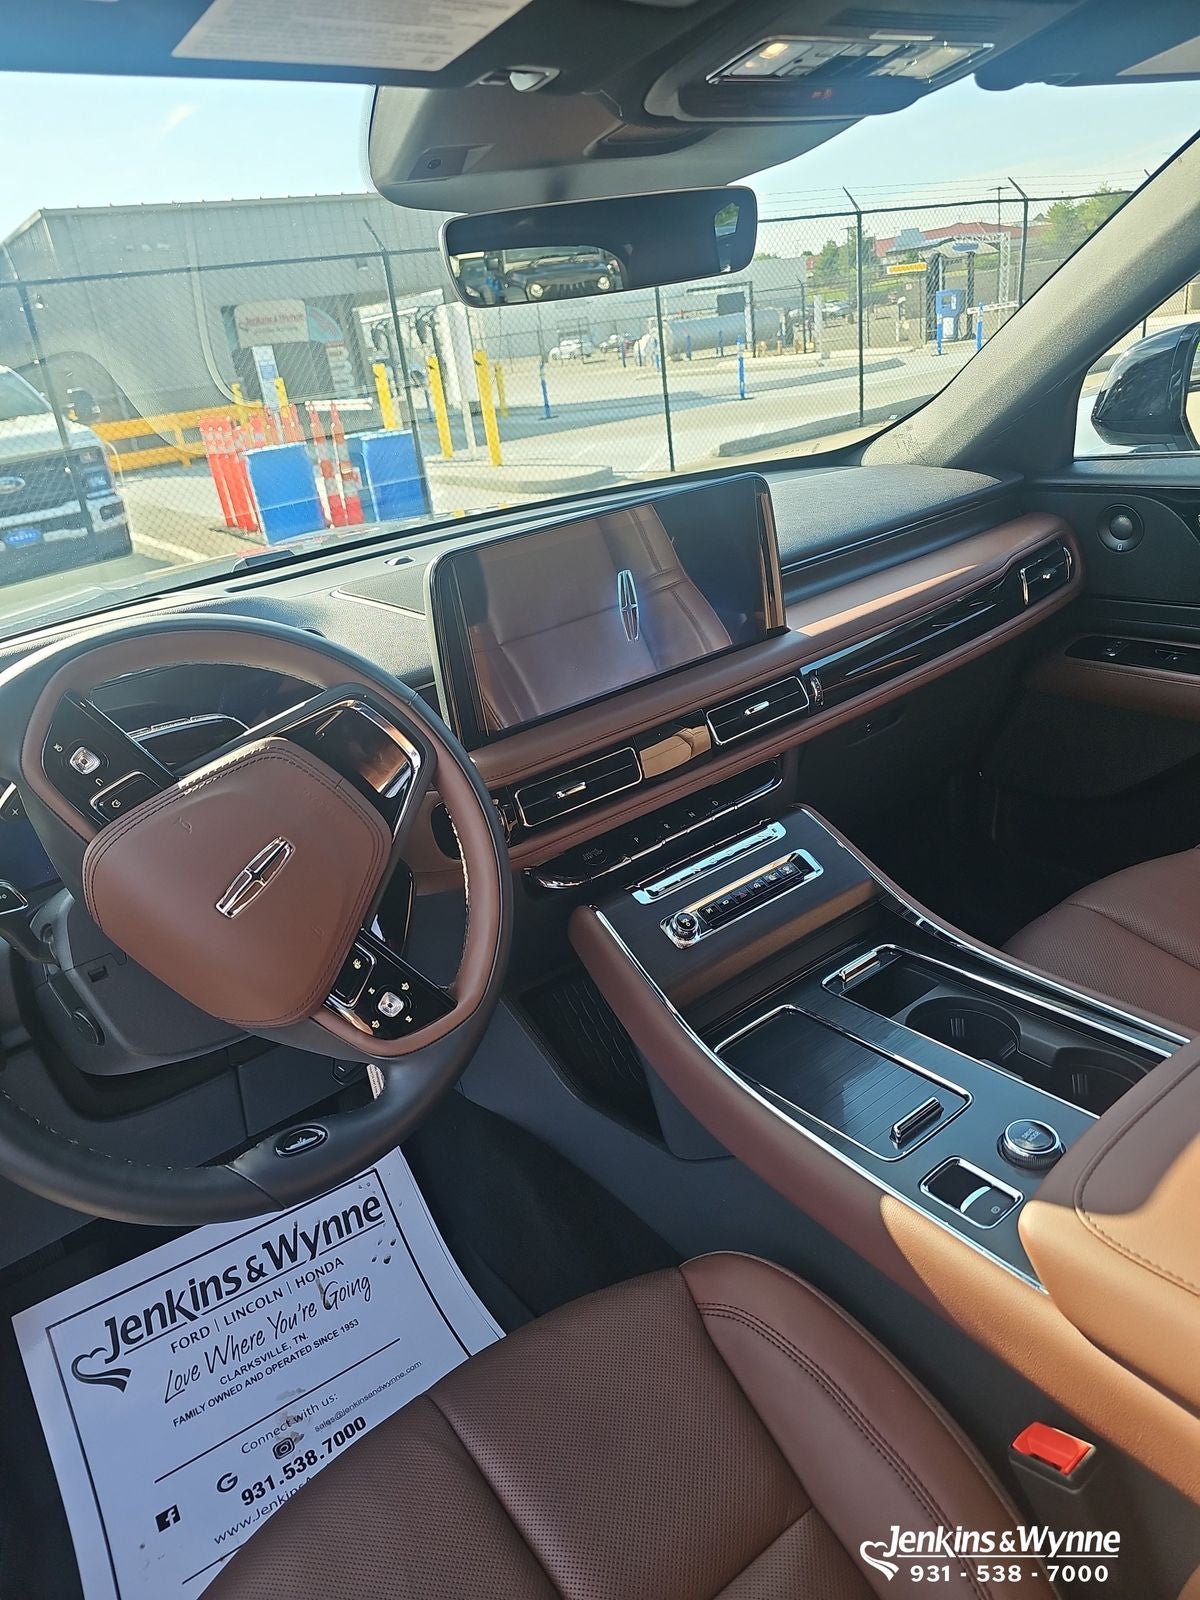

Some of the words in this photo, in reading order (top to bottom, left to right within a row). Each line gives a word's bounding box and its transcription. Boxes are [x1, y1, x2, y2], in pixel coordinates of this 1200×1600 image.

[164, 1364, 201, 1404] Love
[204, 1330, 266, 1374] Where
[267, 1302, 317, 1340] You're
[321, 1276, 371, 1311] Going
[169, 1325, 210, 1353] FORD
[223, 1287, 283, 1327] LINCOLN
[295, 1257, 344, 1288] HONDA
[172, 1403, 206, 1427] FAMILY
[207, 1384, 243, 1408] OWNED
[244, 1373, 264, 1388] AND
[265, 1344, 313, 1376] OPERATED
[314, 1330, 340, 1349] SINCE
[340, 1318, 360, 1334] 1953
[219, 1342, 292, 1385] CLARKSVILLE,
[292, 1332, 309, 1346] TN.
[241, 1419, 292, 1454] Connect
[292, 1402, 320, 1424] with
[321, 1393, 339, 1407] us:
[241, 1416, 367, 1506] 931.538.7000
